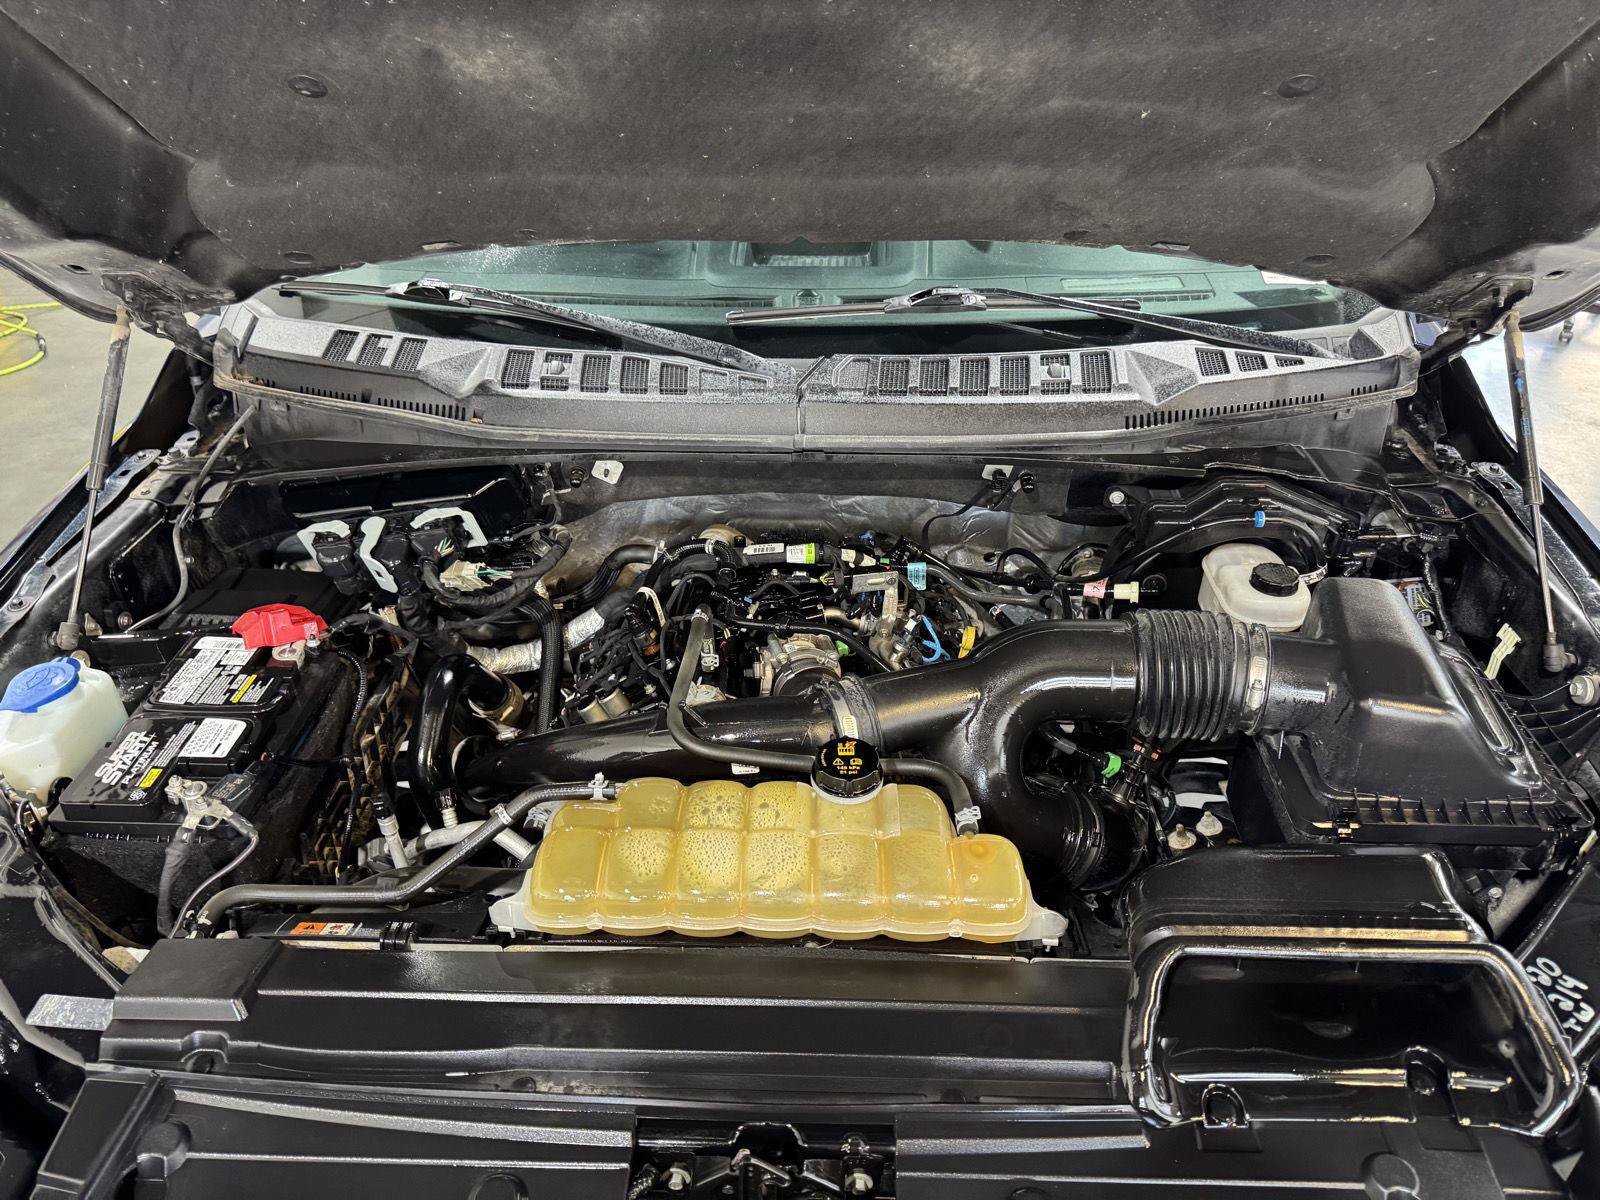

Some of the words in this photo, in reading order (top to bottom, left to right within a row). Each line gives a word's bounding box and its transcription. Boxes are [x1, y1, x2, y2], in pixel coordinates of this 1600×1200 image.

[94, 731, 141, 778] SUPER
[101, 731, 151, 786] START
[121, 741, 159, 785] PLATINUM
